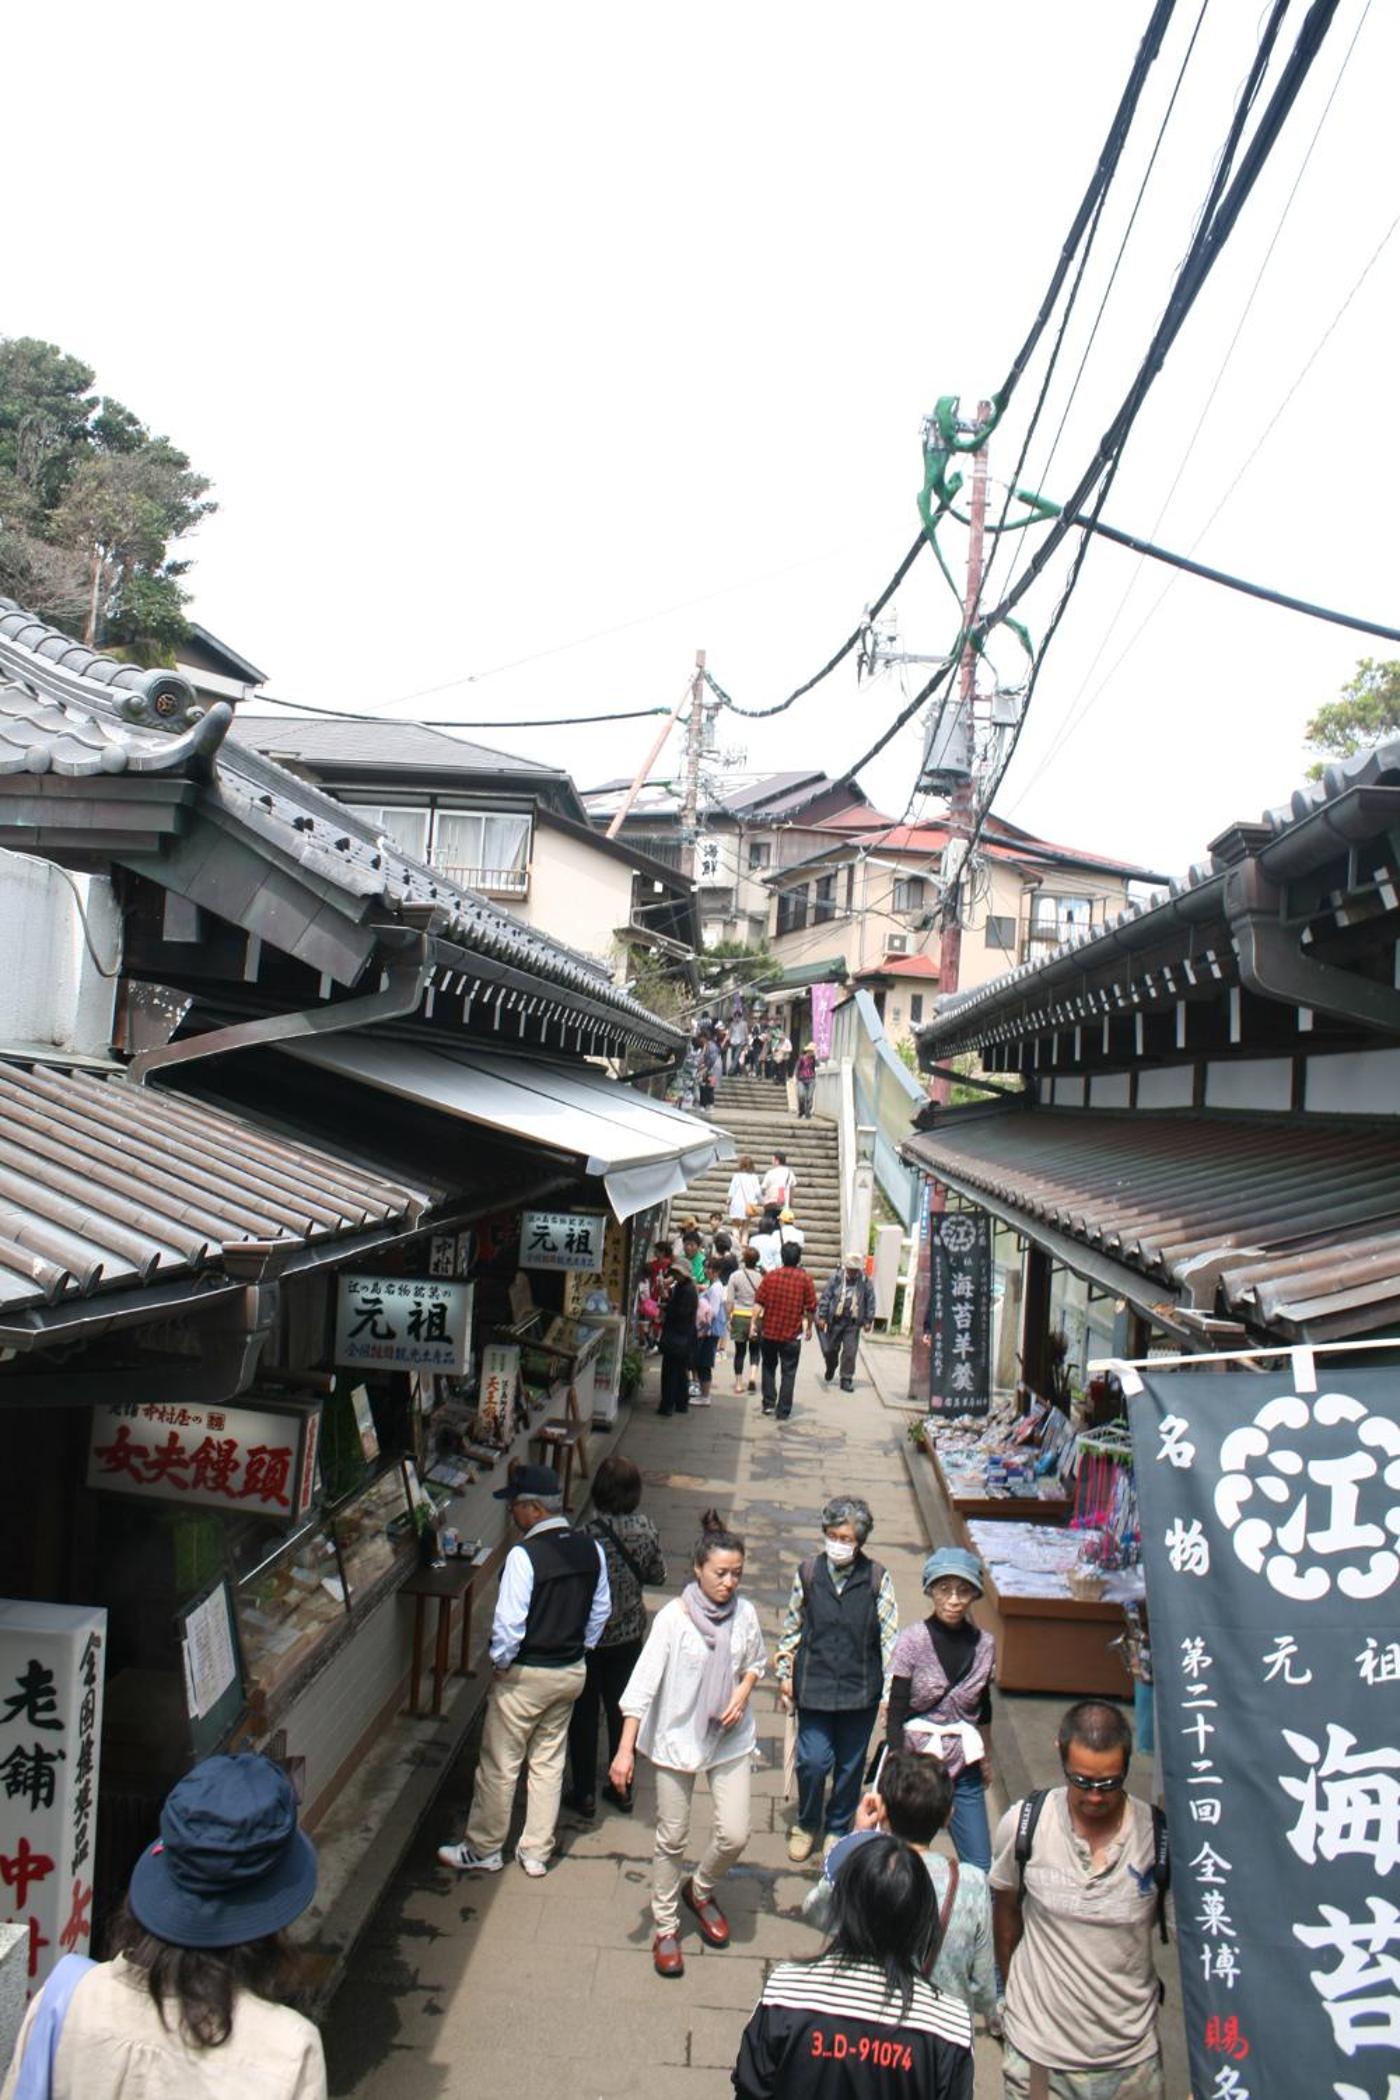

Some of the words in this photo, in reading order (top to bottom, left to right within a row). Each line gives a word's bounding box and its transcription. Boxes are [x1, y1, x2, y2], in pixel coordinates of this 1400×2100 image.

[528, 1226, 594, 1256] 元祖
[348, 1297, 453, 1345] 元祖
[951, 1272, 974, 1391] 海苔羊羹
[95, 1425, 293, 1507] 女夫饅頭
[1156, 1414, 1210, 1576] 名物
[1255, 1450, 1386, 1554] 江
[1262, 1636, 1400, 1686] 元祖
[1278, 1723, 1400, 2100] 海苔
